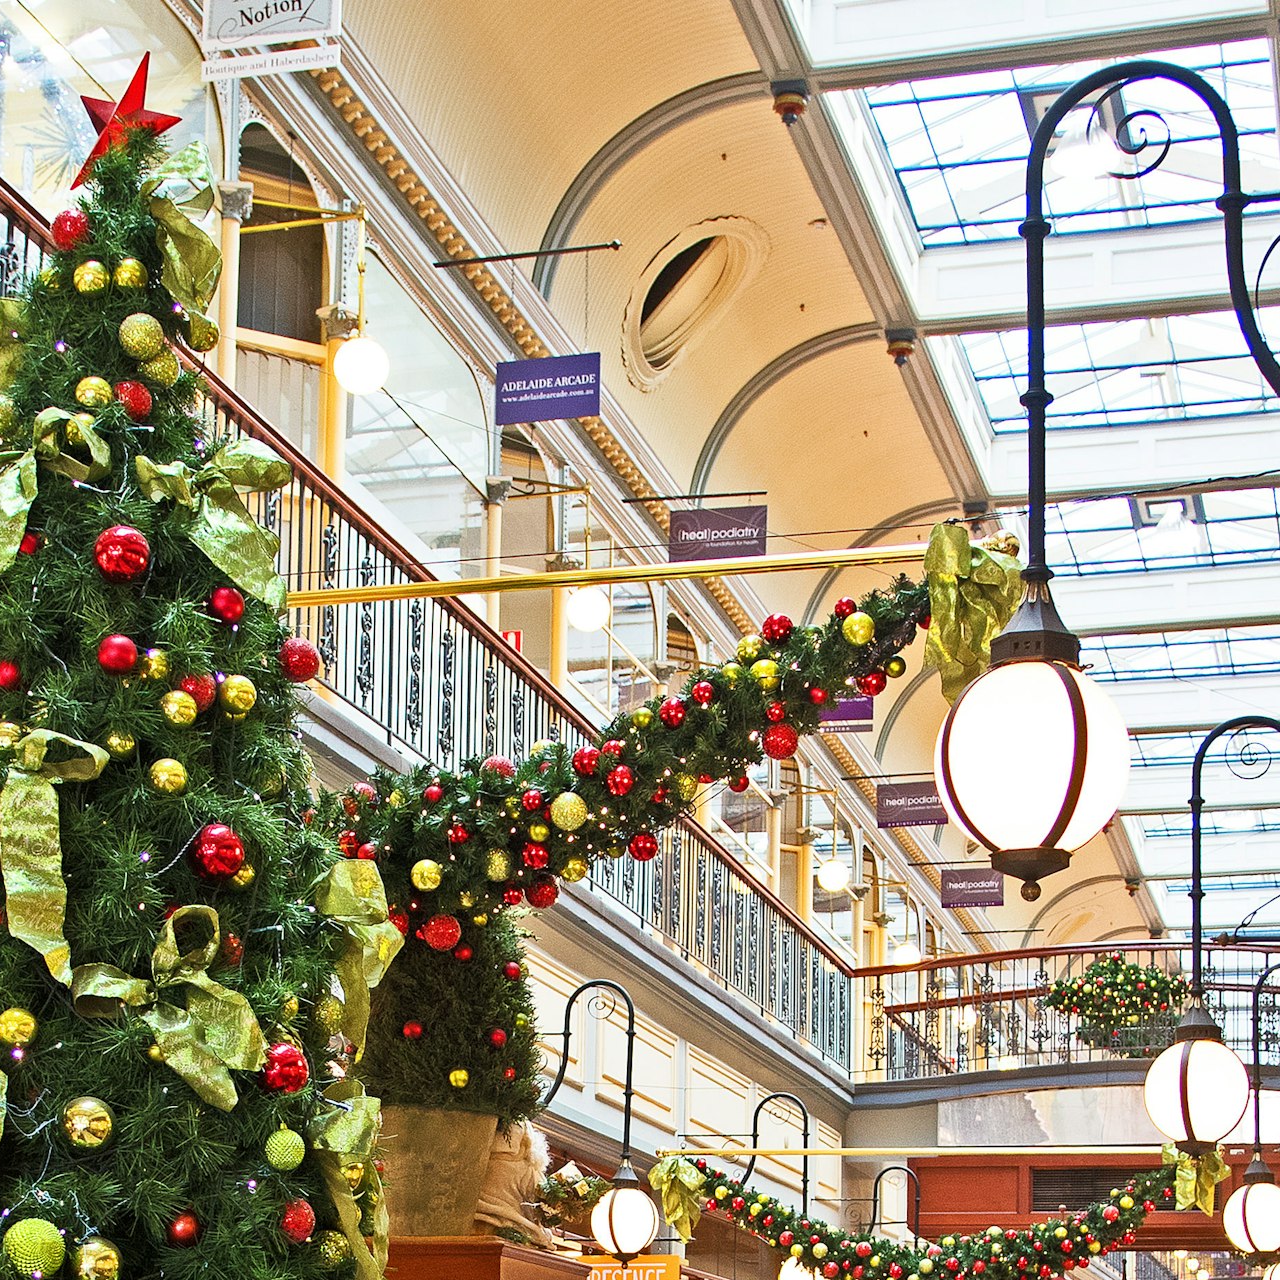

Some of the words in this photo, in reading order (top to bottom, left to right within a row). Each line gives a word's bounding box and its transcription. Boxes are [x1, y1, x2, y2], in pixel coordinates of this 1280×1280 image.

[239, 0, 303, 27] Notion
[205, 63, 246, 76] Boutique
[249, 60, 267, 71] and
[270, 52, 336, 68] Haberdashery
[501, 377, 553, 392] ADELAIDE
[554, 373, 596, 387] ARCADE
[502, 389, 594, 403] www.adelaidearcade.com.au
